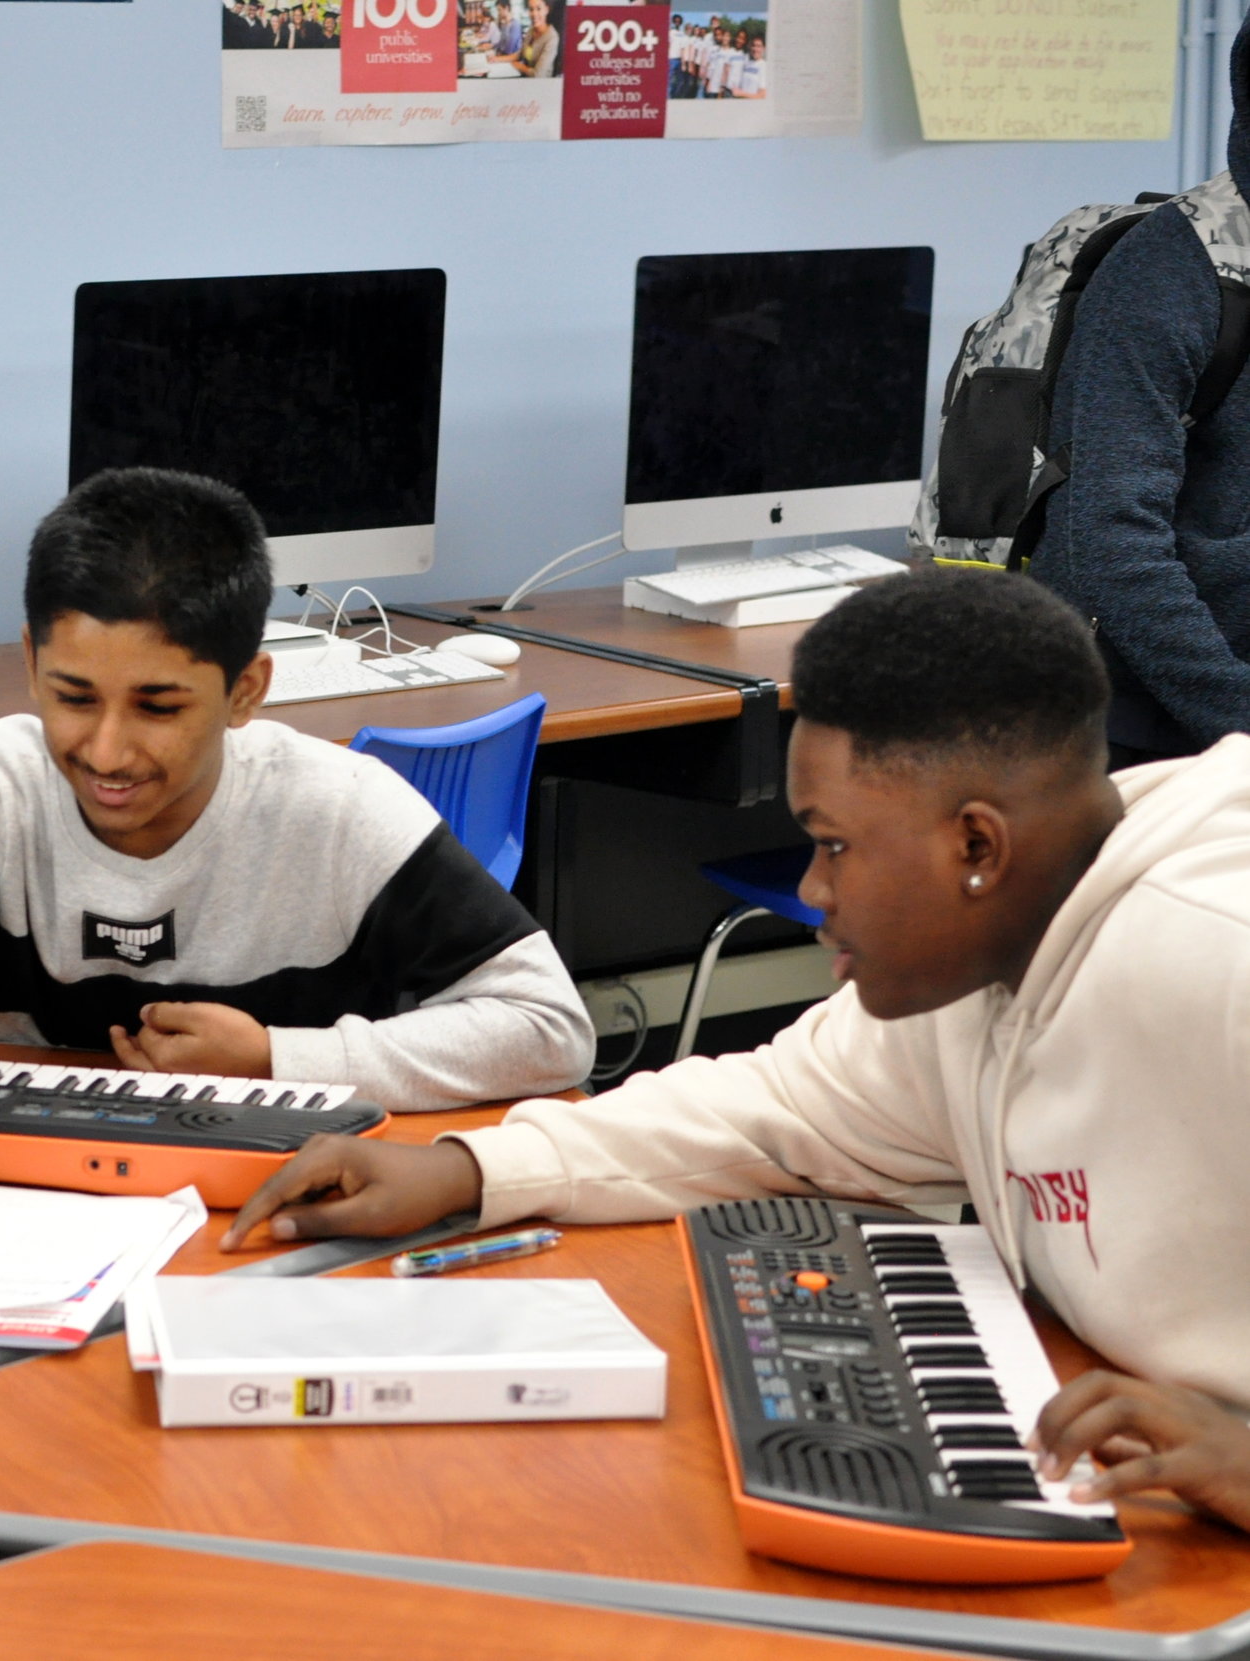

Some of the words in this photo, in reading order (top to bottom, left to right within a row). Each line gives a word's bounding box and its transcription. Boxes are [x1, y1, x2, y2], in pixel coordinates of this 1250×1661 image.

[352, 0, 448, 29] 100
[379, 30, 417, 48] public
[577, 20, 659, 52] 200+
[366, 51, 433, 66] universities
[589, 54, 629, 72] colleges
[633, 53, 656, 70] and
[581, 73, 642, 87] universities
[597, 90, 624, 104] with
[625, 91, 643, 104] no
[580, 105, 640, 122] application
[642, 105, 659, 121] fee
[96, 922, 163, 947] PUMA
